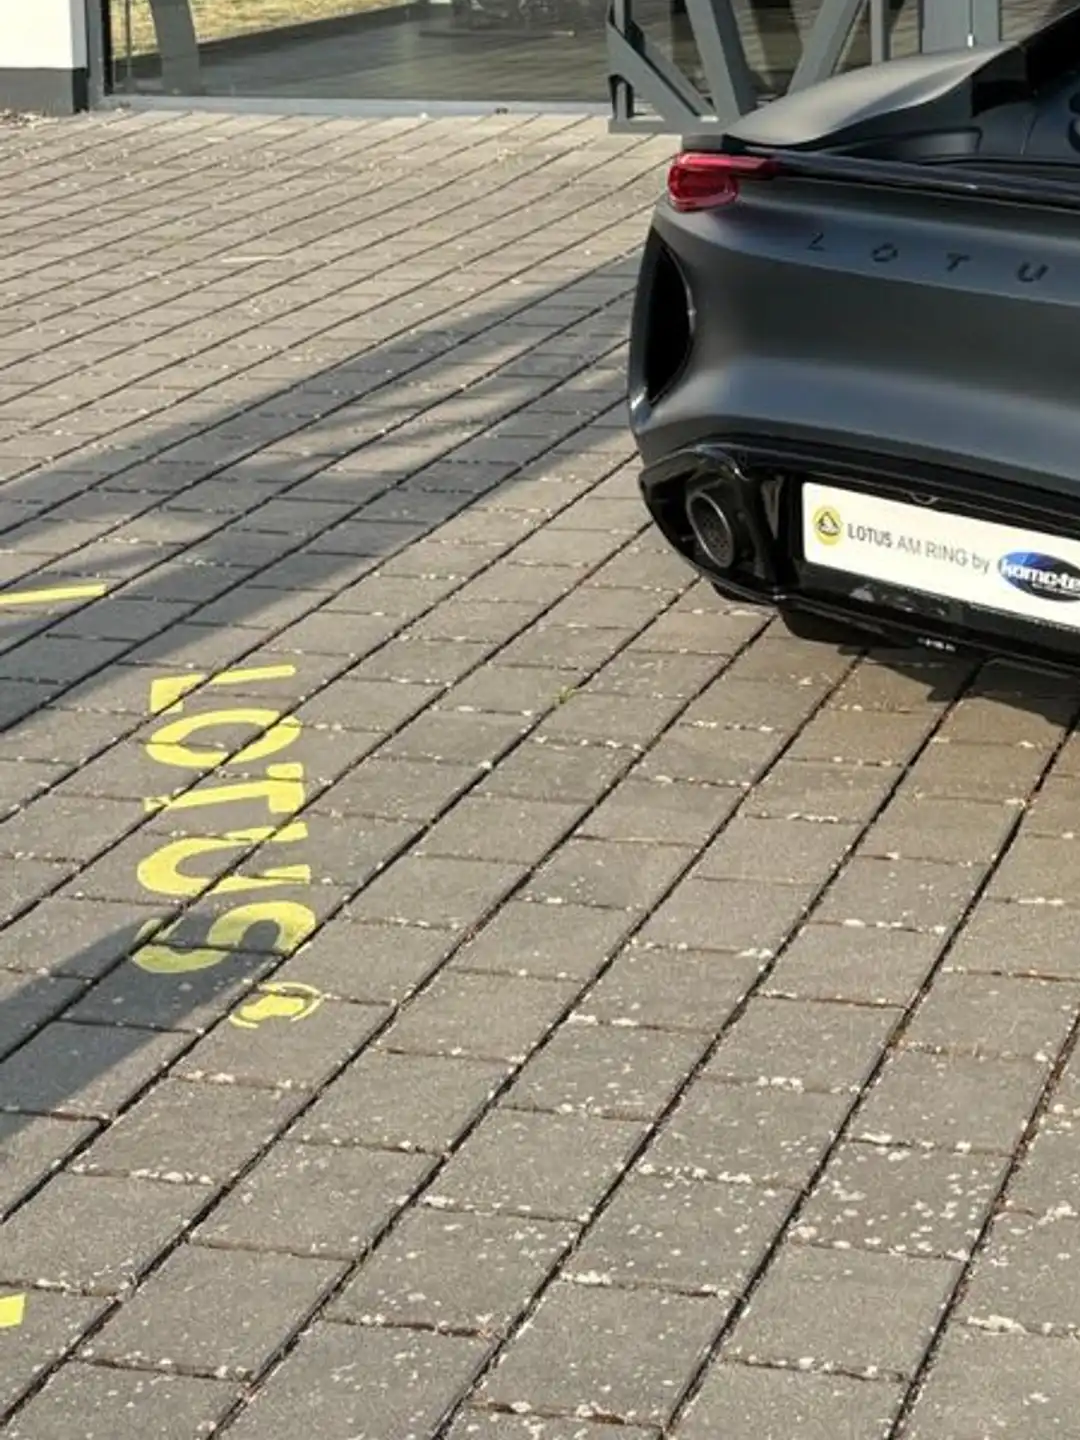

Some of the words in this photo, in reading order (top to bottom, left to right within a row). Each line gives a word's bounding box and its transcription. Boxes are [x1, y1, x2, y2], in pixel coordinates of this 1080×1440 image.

[847, 523, 892, 548] LOTUS
[897, 535, 921, 555] AM
[925, 540, 968, 567] RING
[971, 552, 990, 574] by
[131, 665, 316, 974] LOTUS
